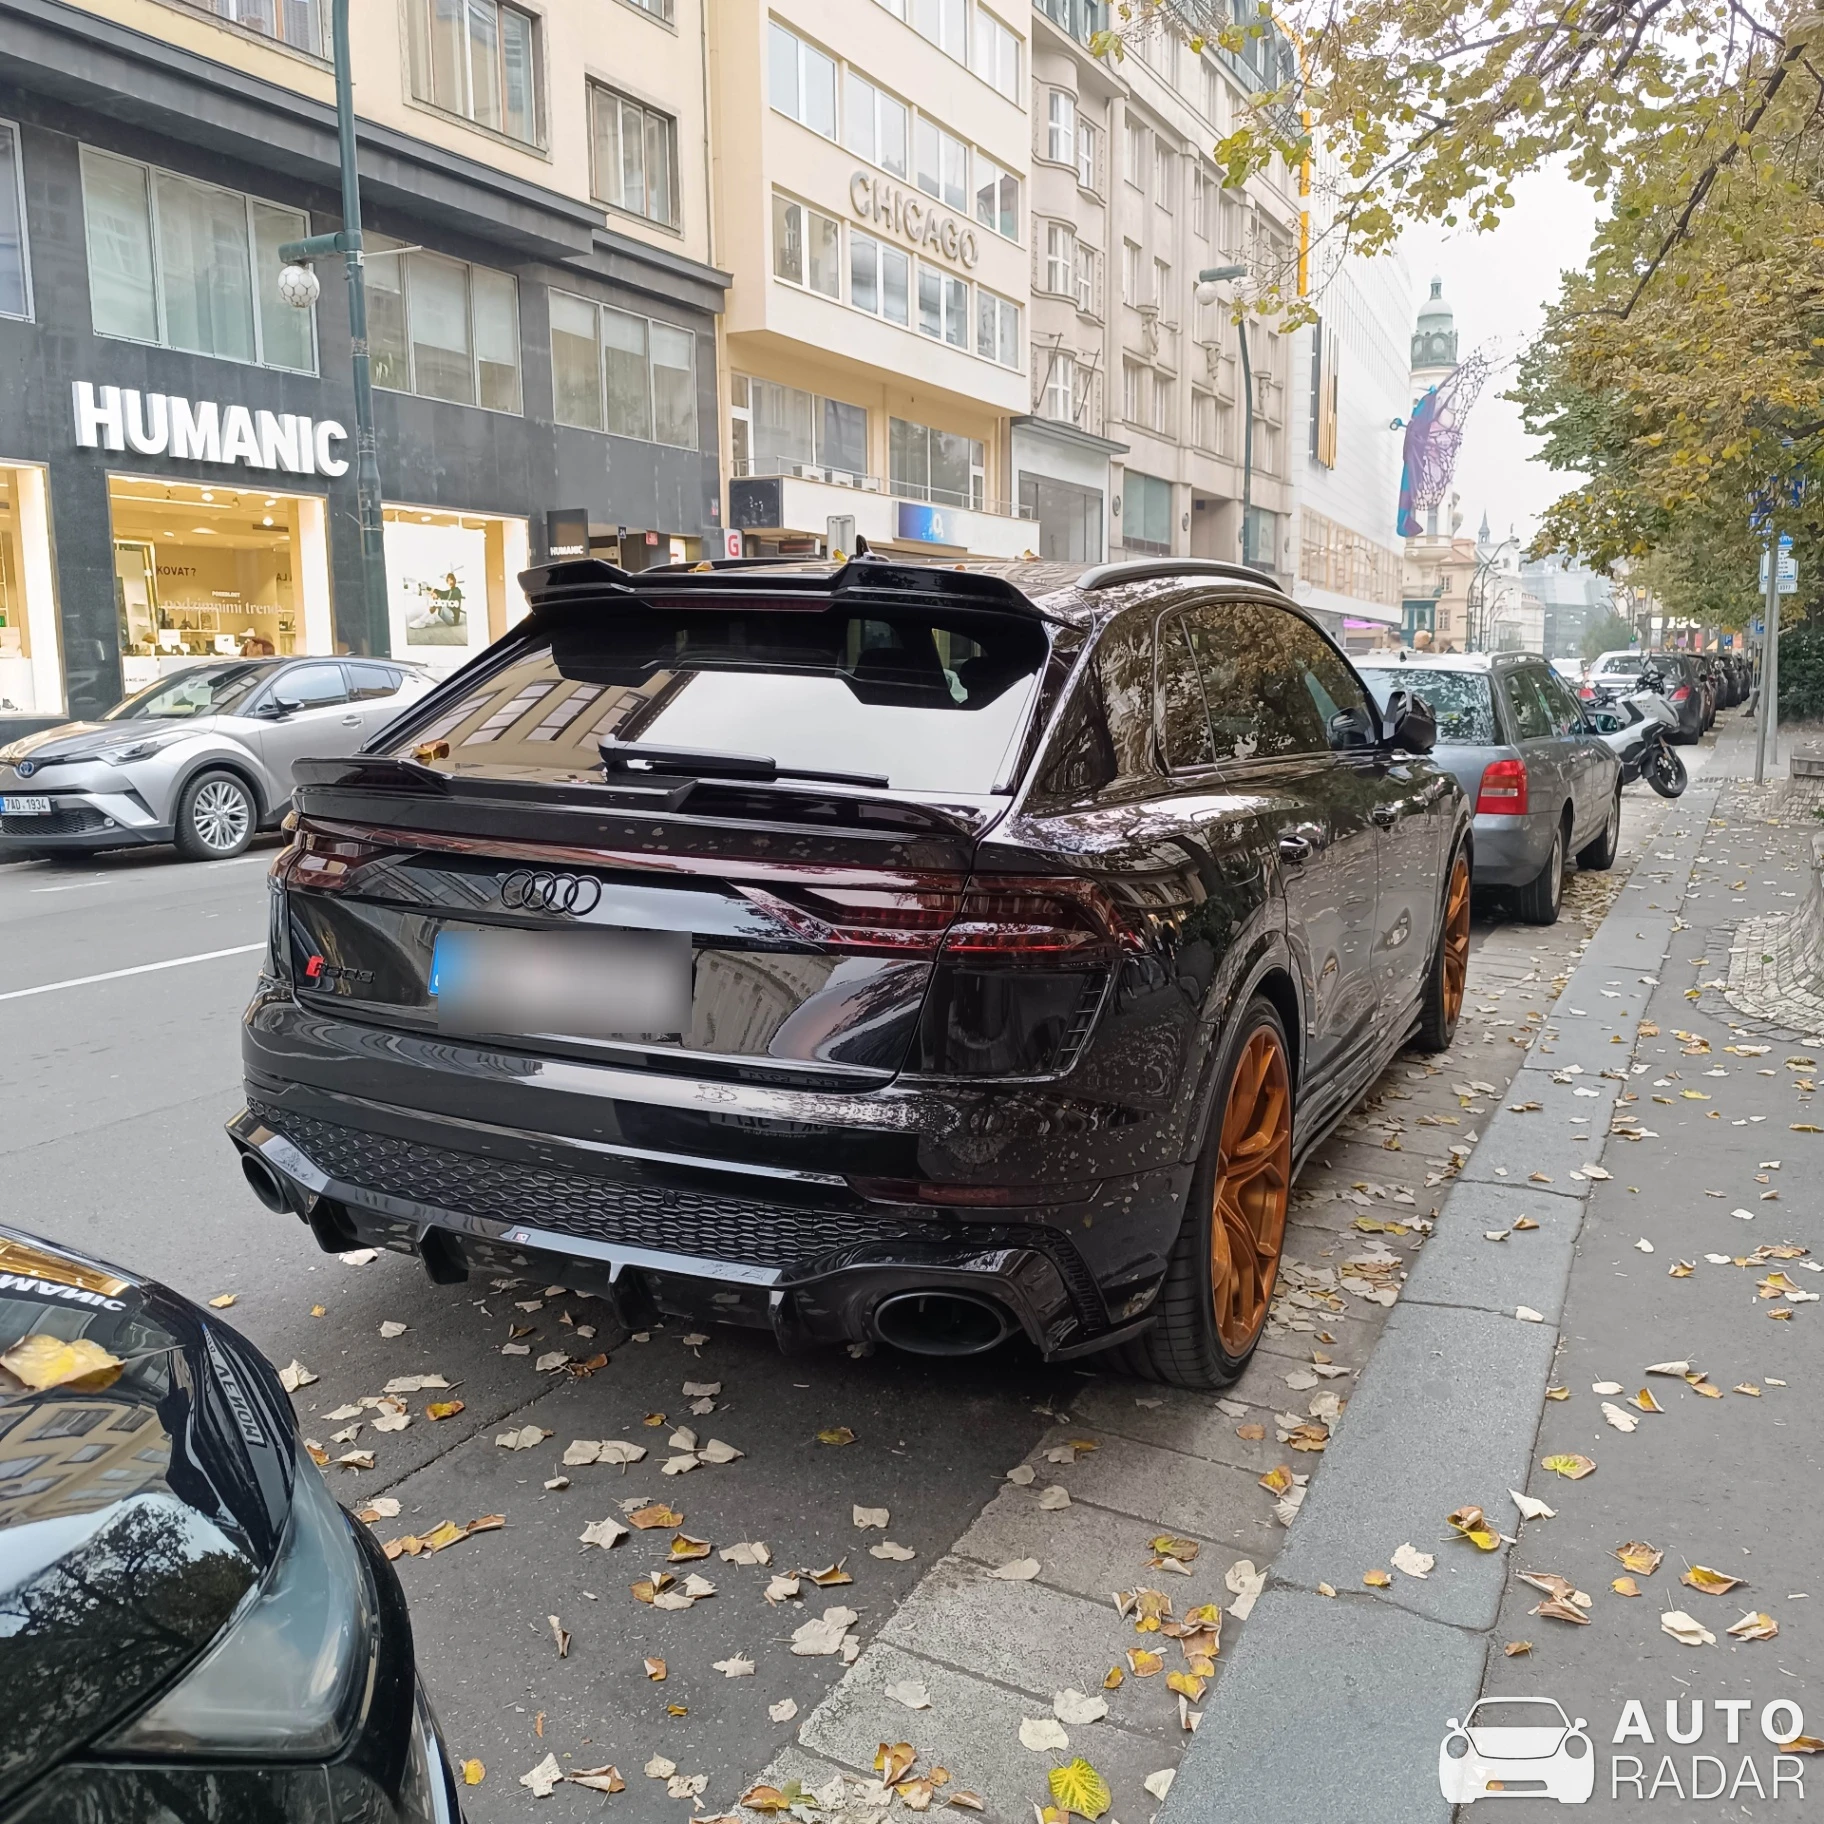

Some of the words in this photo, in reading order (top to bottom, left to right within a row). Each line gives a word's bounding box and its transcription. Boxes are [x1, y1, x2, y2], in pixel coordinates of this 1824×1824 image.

[850, 170, 978, 269] CHICAGO
[72, 381, 349, 477] HUMANIC
[550, 545, 584, 556] HUMANIC
[728, 535, 739, 556] G
[5, 798, 21, 810] 7AD
[26, 798, 46, 810] 1934
